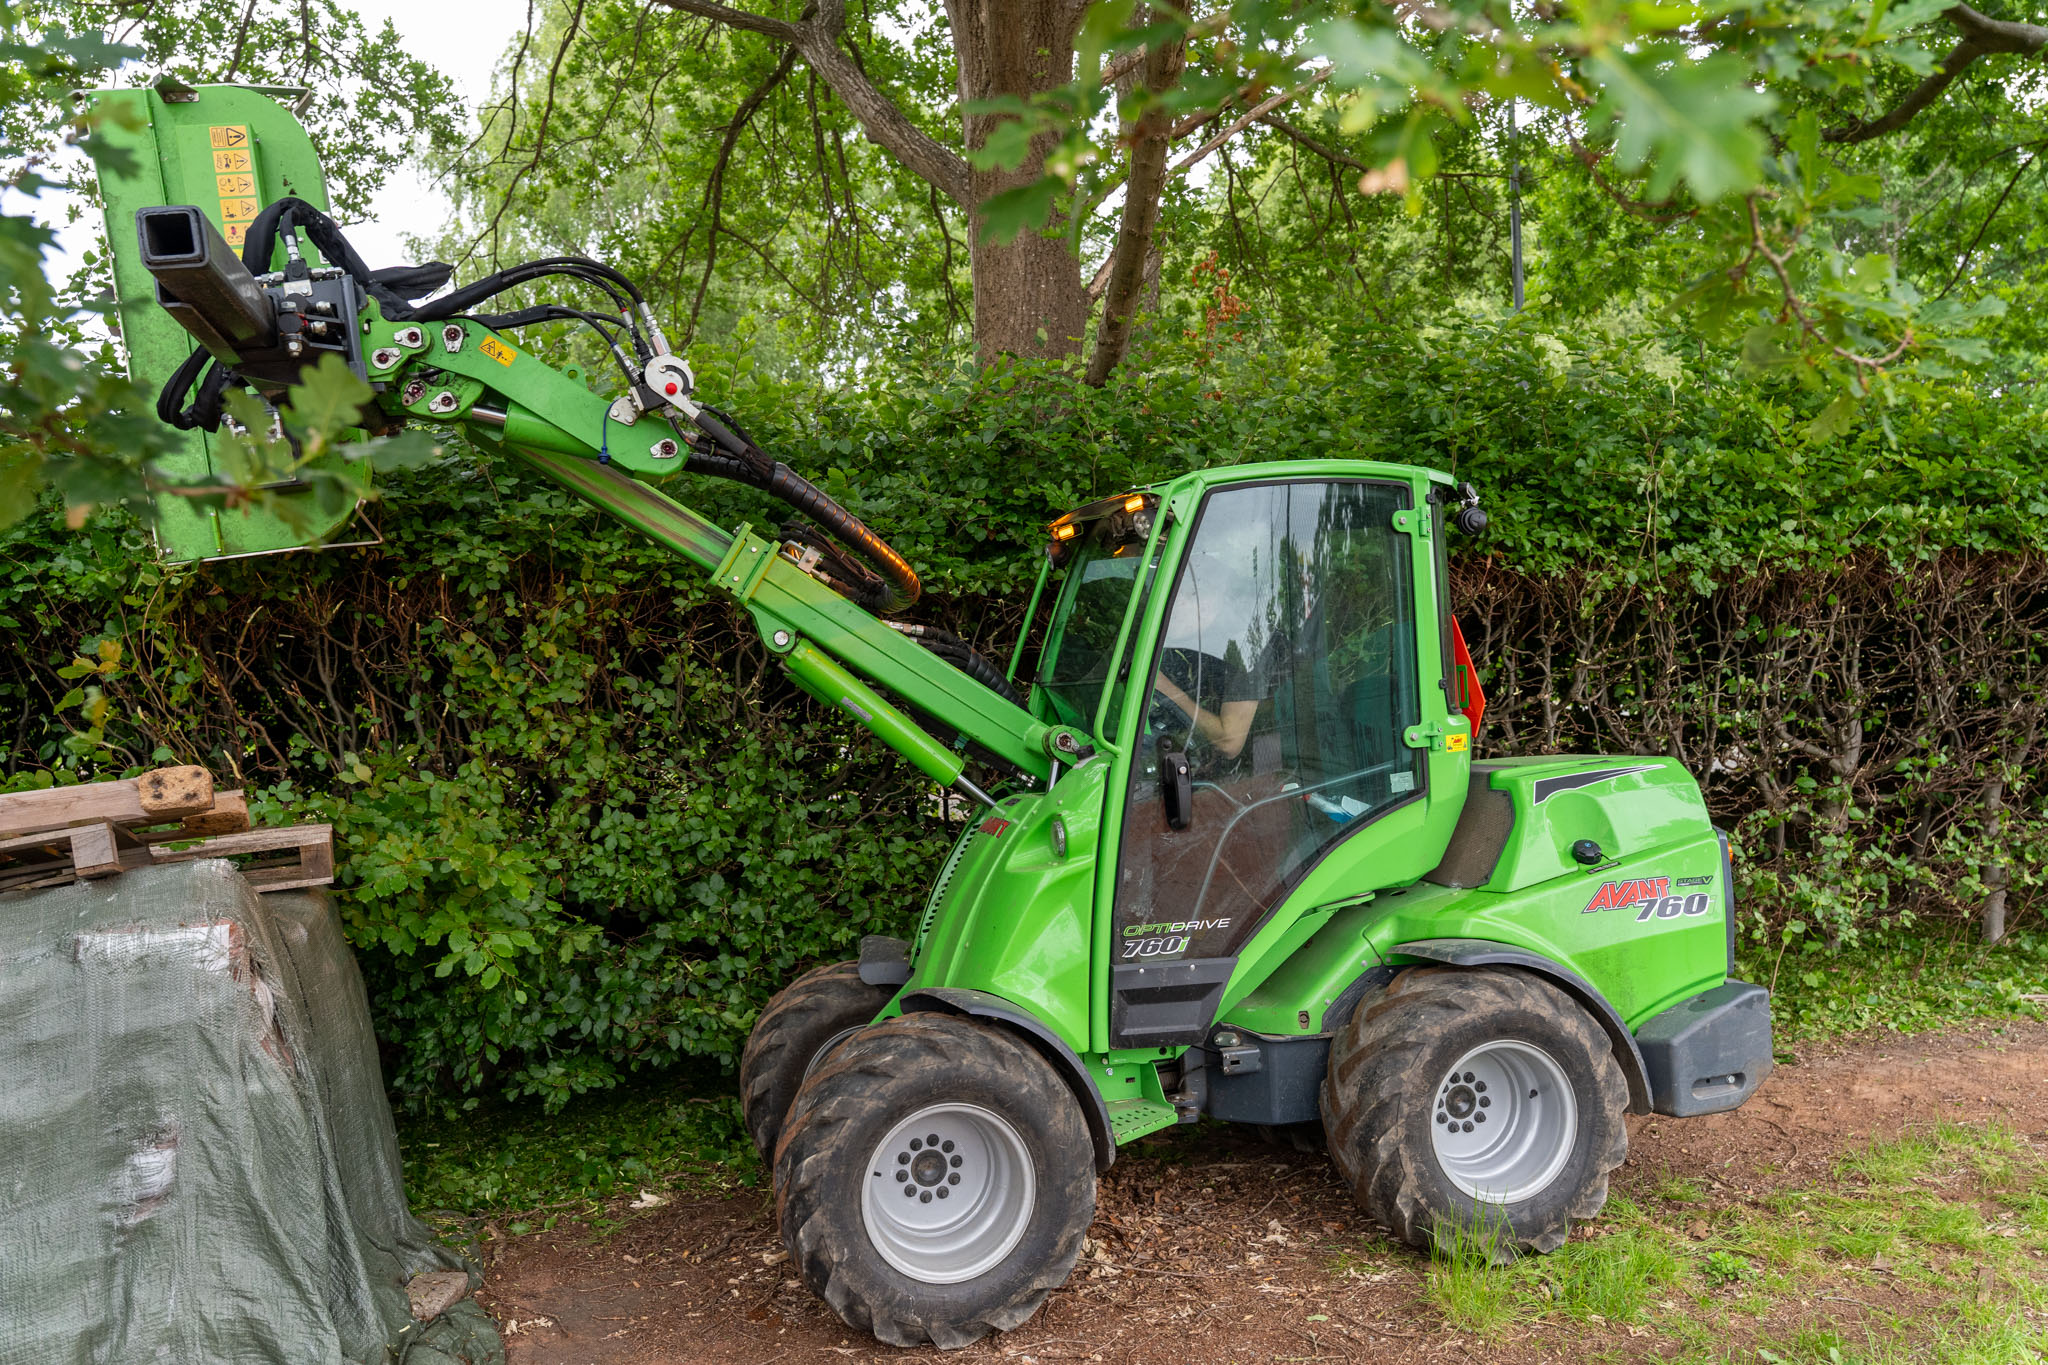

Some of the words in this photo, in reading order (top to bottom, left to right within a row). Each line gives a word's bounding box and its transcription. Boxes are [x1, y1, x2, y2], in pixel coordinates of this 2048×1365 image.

[1582, 876, 1671, 914] AVANT
[1123, 918, 1231, 937] OPTIDRIVE
[1122, 935, 1190, 958] 760i
